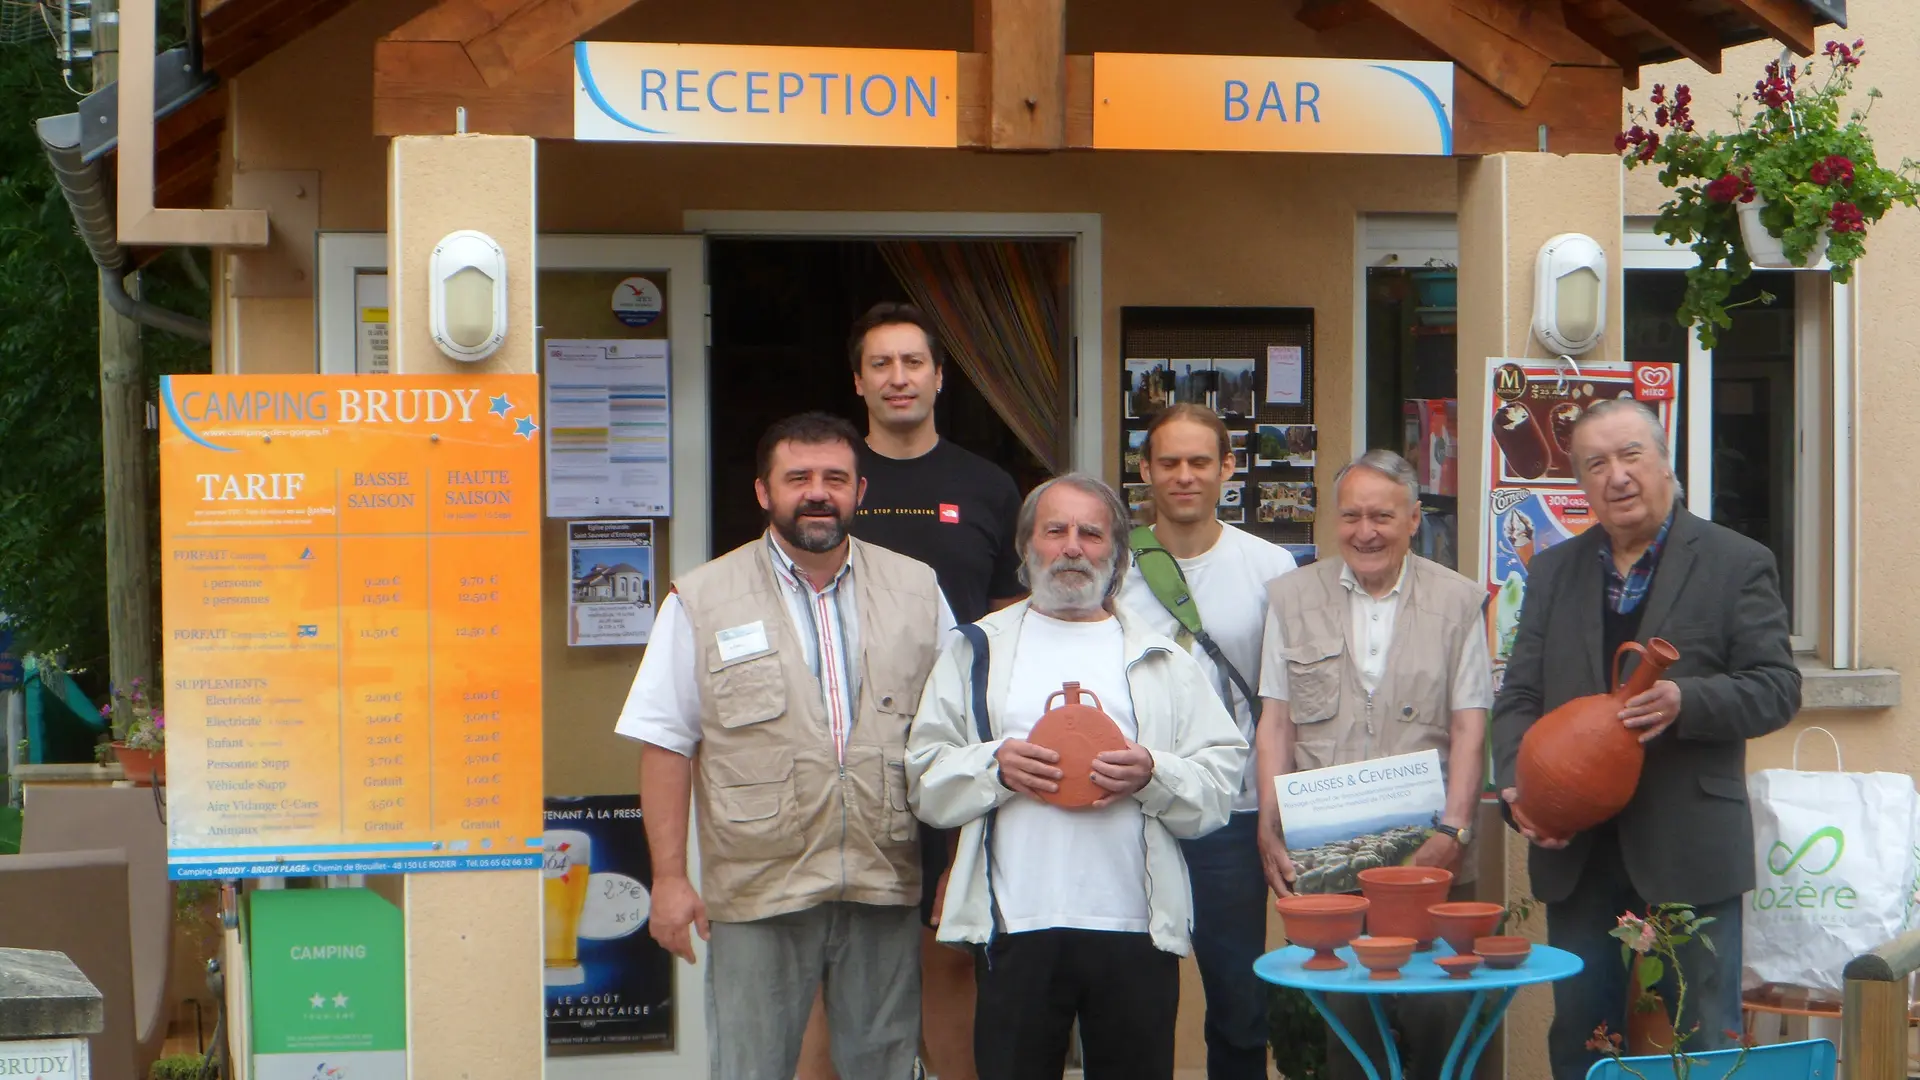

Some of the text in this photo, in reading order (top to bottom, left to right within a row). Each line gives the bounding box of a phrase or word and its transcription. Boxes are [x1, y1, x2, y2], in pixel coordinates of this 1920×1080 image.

[640, 68, 937, 117] RECEPTION
[1224, 80, 1321, 123] BAR
[182, 389, 480, 422] CAMPING BRUDY
[354, 472, 409, 486] BASSE
[447, 470, 510, 484] HAUTE
[196, 473, 305, 500] TARIF
[348, 494, 416, 508] SAISON
[445, 490, 511, 504] SAISON
[1491, 488, 1530, 515] Cornetto
[1549, 495, 1568, 506] 300
[173, 550, 228, 560] FORFAIT
[211, 580, 263, 590] personne
[392, 575, 401, 586] €
[490, 574, 499, 585] €
[212, 596, 270, 607] personnes
[392, 591, 401, 603] €
[490, 590, 499, 602] €
[173, 629, 228, 640] FORFAIT
[390, 626, 399, 637] €
[490, 624, 499, 636] €
[175, 678, 268, 690] SUPPLEMENTS
[393, 691, 402, 702] €
[491, 689, 500, 700] €
[394, 713, 402, 723] €
[491, 710, 500, 721] €
[394, 734, 403, 744] €
[491, 731, 500, 742] €
[206, 738, 244, 749] Enfant
[394, 754, 403, 765] €
[491, 752, 500, 763] €
[206, 758, 290, 771] Personne Supp
[363, 776, 403, 787] Gratuit
[492, 774, 501, 784] €
[1287, 776, 1344, 796] CAUSSES
[1347, 774, 1357, 786] &
[1358, 762, 1429, 785] CEVENNES
[206, 779, 287, 793] Véhicule Supp
[396, 797, 404, 807] €
[491, 794, 500, 805] €
[206, 801, 230, 812] Aire
[233, 799, 277, 812] Vidange
[586, 807, 594, 819] À
[597, 809, 610, 819] LA
[613, 808, 643, 819] PRESS
[364, 820, 404, 831] Gratuit
[461, 819, 500, 830] Gratuit
[206, 825, 259, 837] Animaux
[177, 867, 213, 877] Camping
[251, 865, 279, 874] BRUDY
[313, 863, 342, 873] Chemin
[343, 863, 354, 872] de
[404, 860, 417, 869] 150
[418, 860, 428, 869] LE
[429, 859, 457, 869] ROZIER
[489, 858, 500, 867] 65
[501, 858, 511, 866] 62
[523, 858, 533, 866] 33
[290, 945, 367, 960] CAMPING
[557, 994, 620, 1005] LE GOÛT
[568, 1006, 650, 1018] FRANÇAISE
